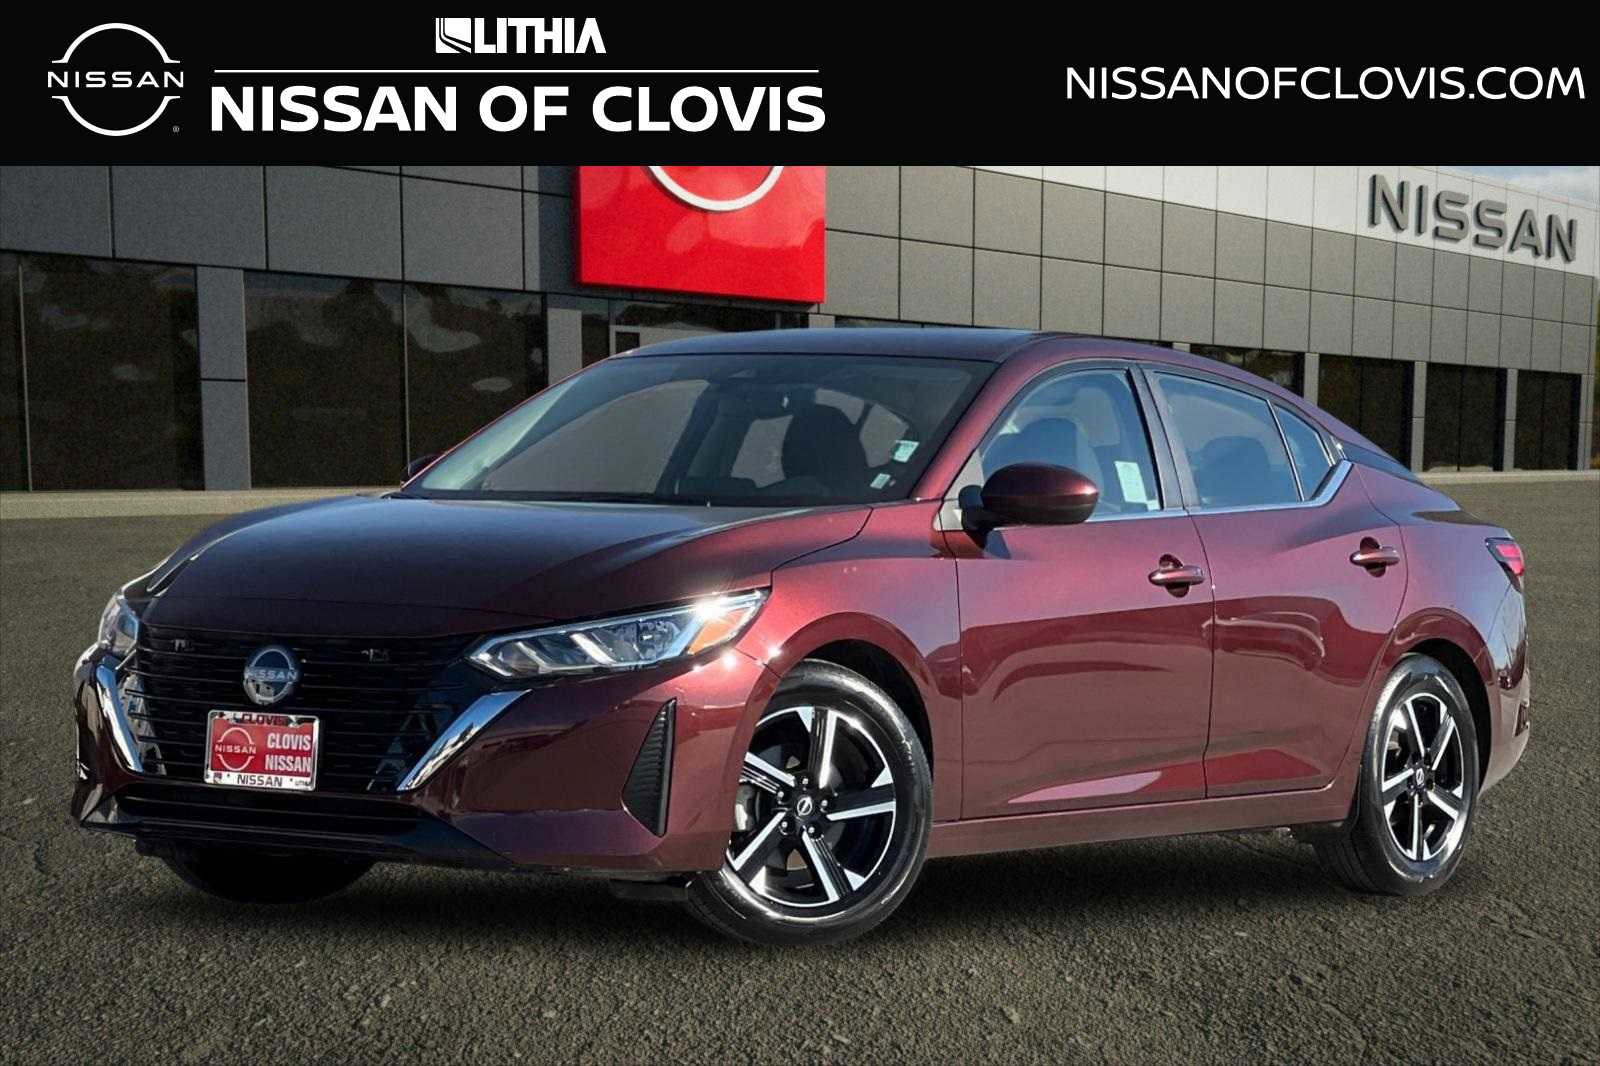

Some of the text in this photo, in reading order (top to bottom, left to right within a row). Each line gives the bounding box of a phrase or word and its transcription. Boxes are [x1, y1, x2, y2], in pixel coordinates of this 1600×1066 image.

[1368, 174, 1577, 263] NISSAN
[245, 669, 297, 680] NISSAN
[215, 744, 256, 754] NISSAN
[267, 733, 311, 751] CLOVIS
[265, 754, 311, 773] NISSAN
[236, 774, 283, 787] NISSAN
